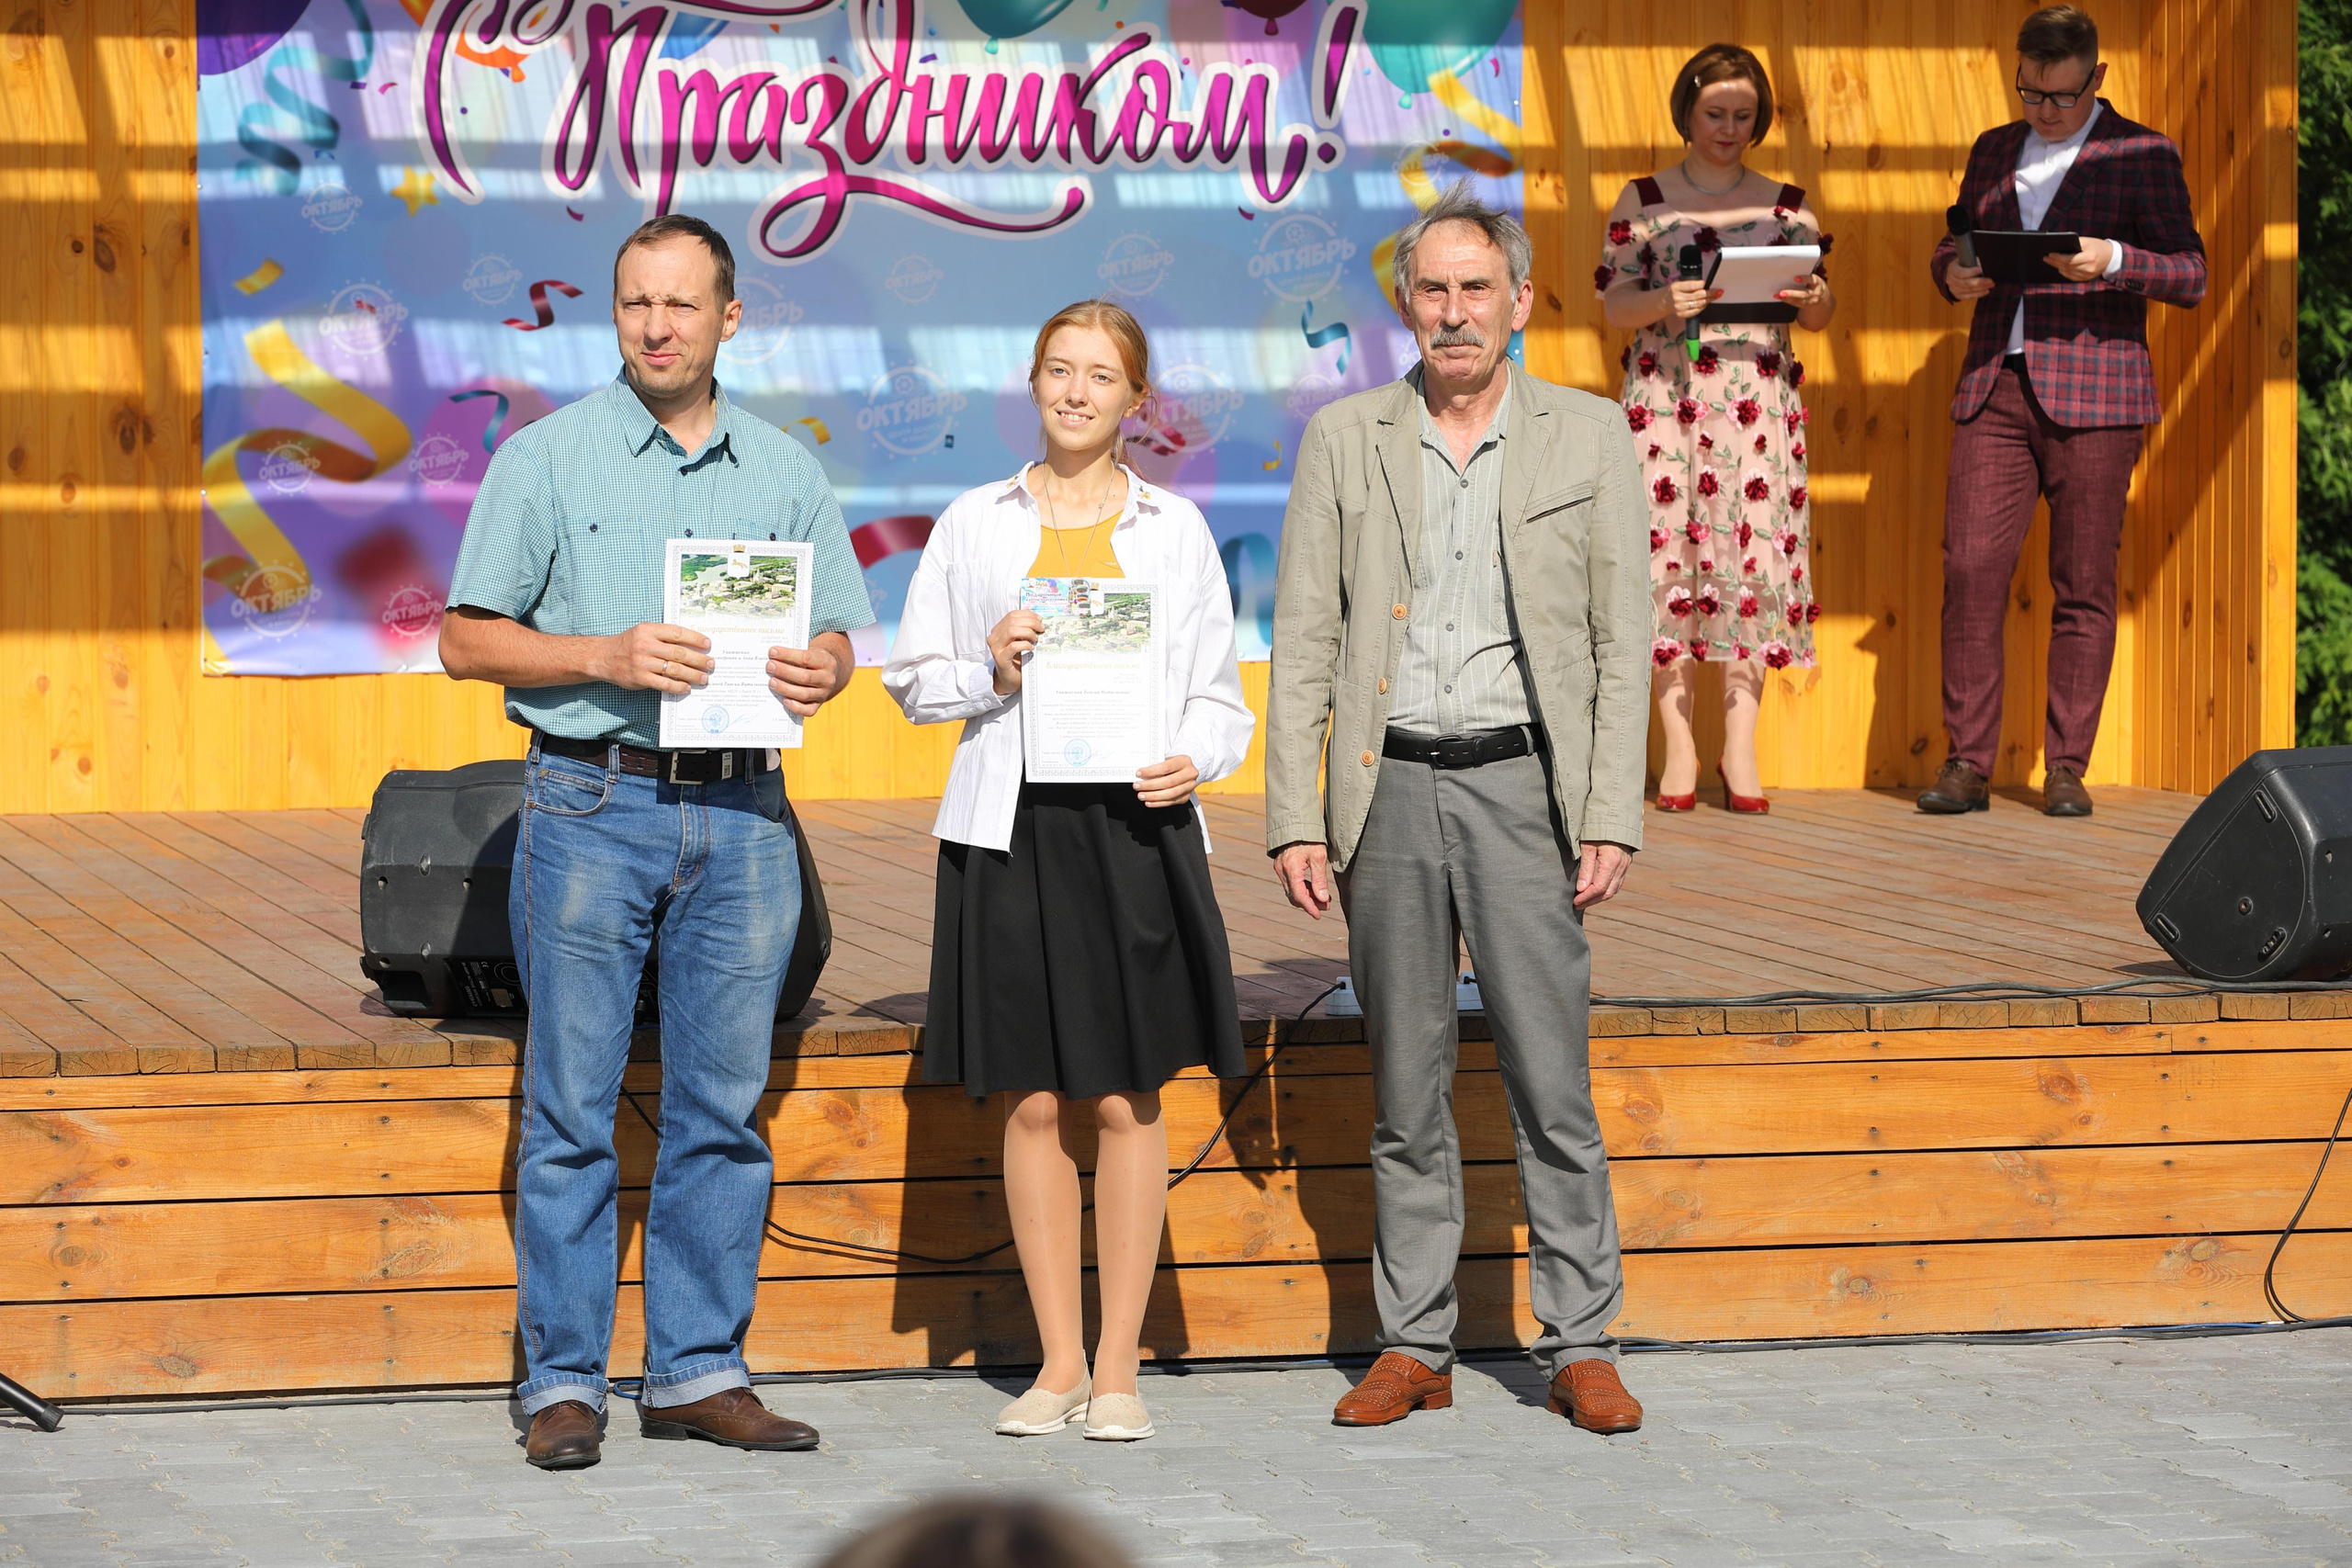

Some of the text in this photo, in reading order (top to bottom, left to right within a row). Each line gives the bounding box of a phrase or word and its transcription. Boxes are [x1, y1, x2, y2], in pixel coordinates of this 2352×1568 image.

[301, 196, 363, 219] ОКТЯБРЬ
[1097, 250, 1175, 279] ОКТЯБРЬ
[1248, 236, 1357, 279] ОКТЯБРЬ
[462, 264, 523, 292] ОКТЯБРЬ
[885, 268, 944, 290] ОКТЯБРЬ
[856, 389, 967, 432] ОКТЯБРЬ
[259, 457, 321, 479] ОКТЯБРЬ
[409, 450, 469, 473] ОКТЯБРЬ
[232, 584, 322, 618] ОКТЯБРЬ
[382, 599, 443, 625] ОКТЯБРЬ
